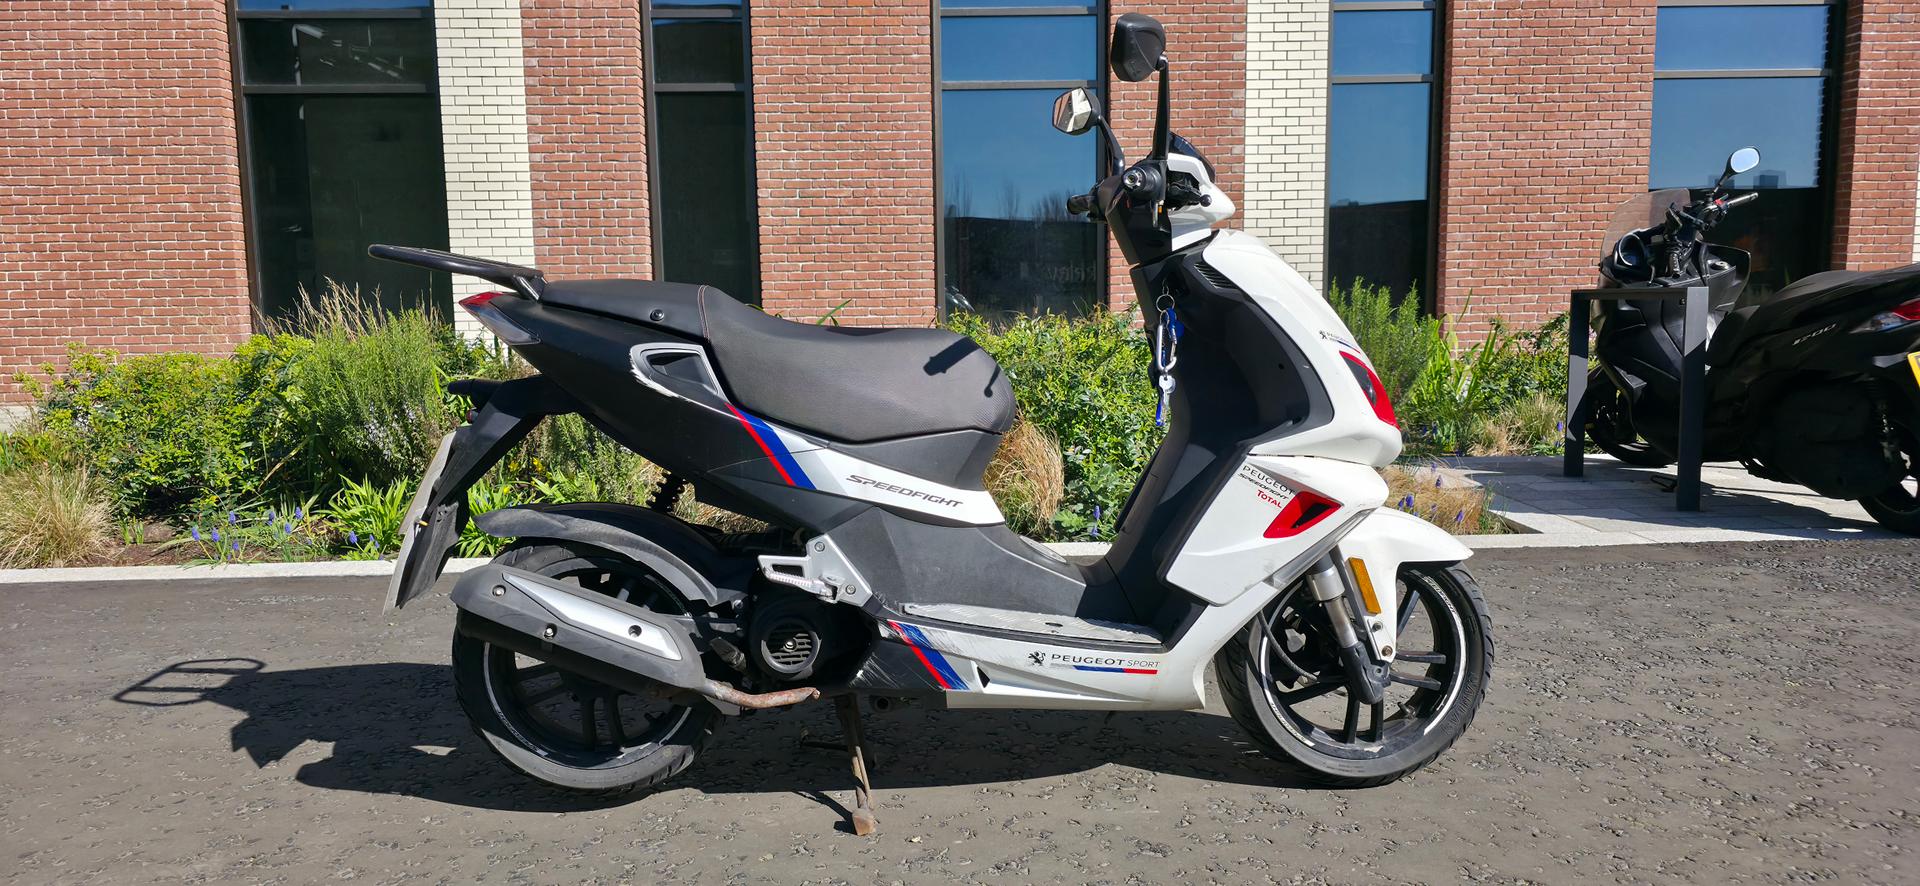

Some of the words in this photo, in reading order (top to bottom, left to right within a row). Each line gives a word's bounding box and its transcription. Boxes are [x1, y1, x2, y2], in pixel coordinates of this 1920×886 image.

[846, 474, 965, 508] SPEEDFIGHT
[1242, 464, 1297, 496] PEUGEOT
[1257, 489, 1283, 509] TOTAL
[1051, 652, 1126, 666] PEUGEOT
[1126, 658, 1161, 668] SPORT
